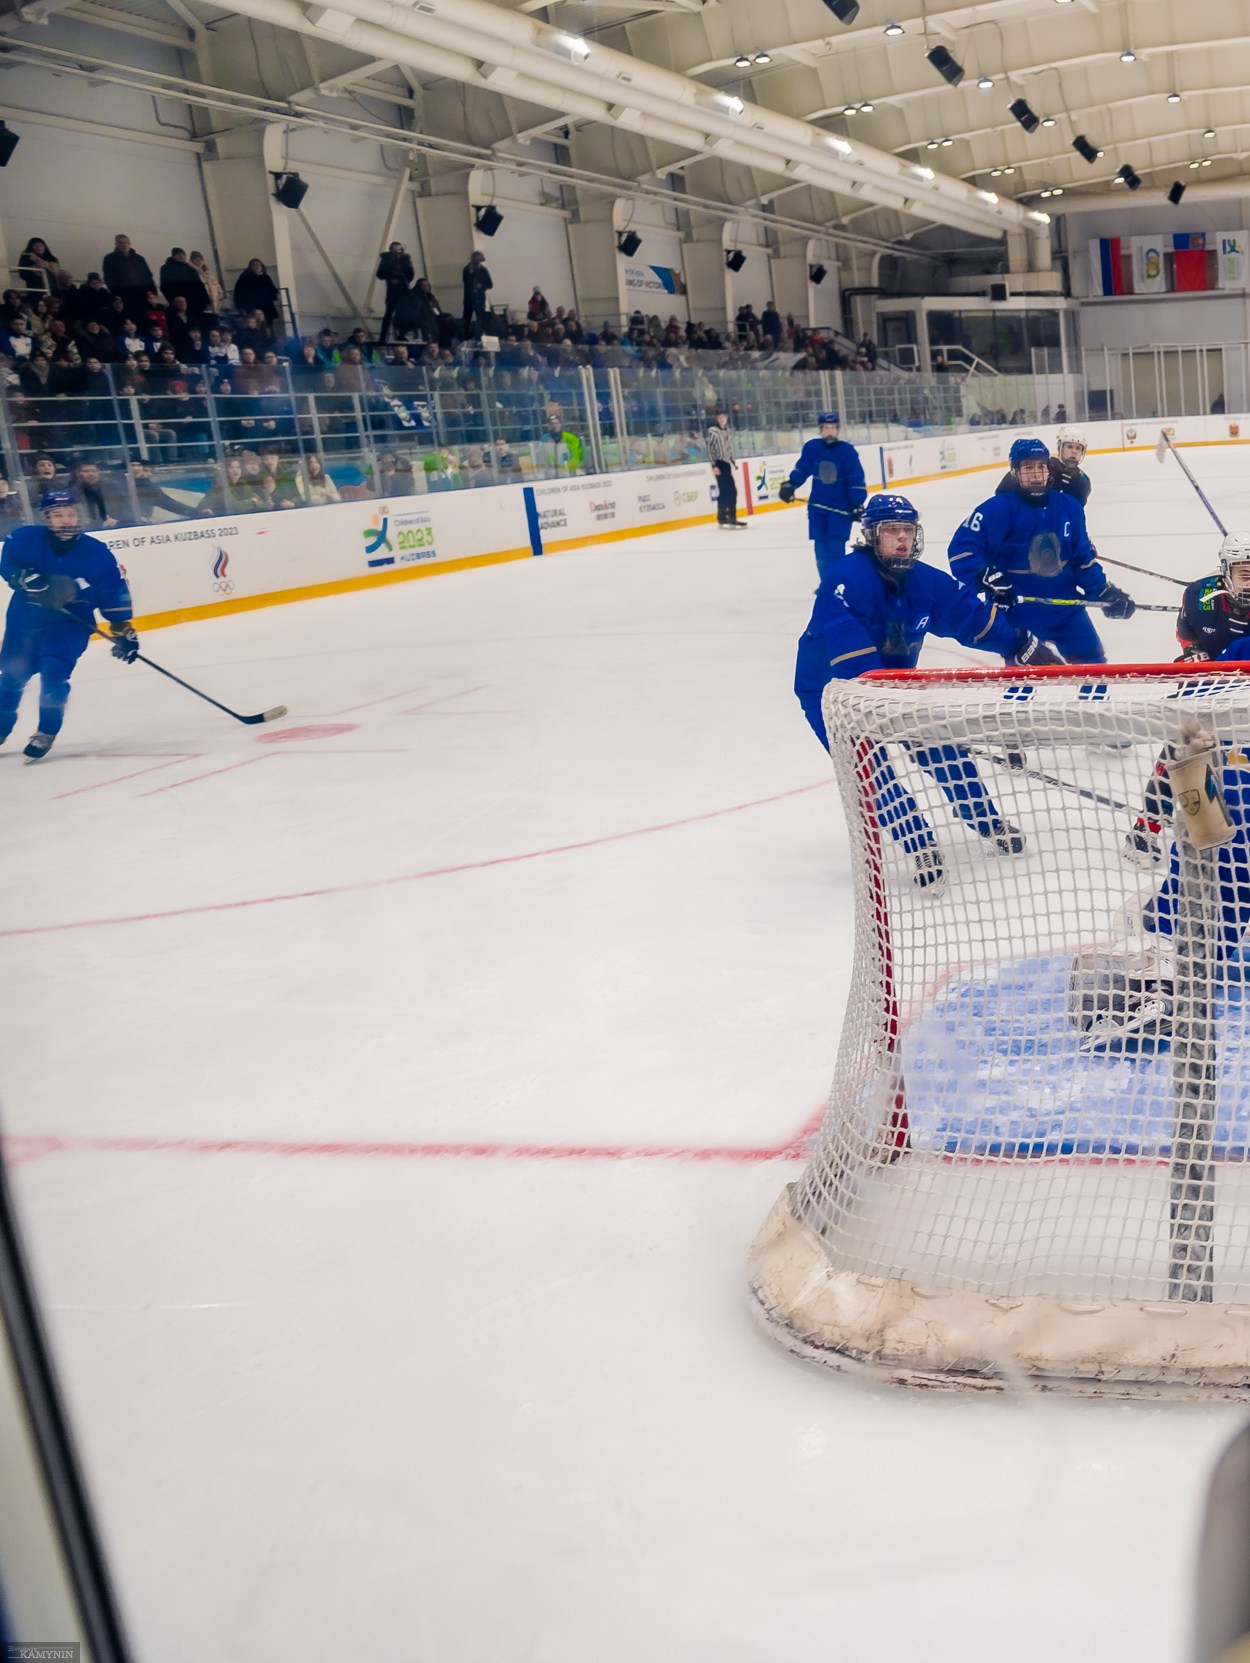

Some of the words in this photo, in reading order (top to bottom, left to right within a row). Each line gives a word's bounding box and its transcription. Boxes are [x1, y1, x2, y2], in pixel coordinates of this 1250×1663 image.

[132, 536, 146, 548] OF
[150, 534, 171, 545] ASIA
[174, 529, 216, 542] KUZBASS
[218, 526, 239, 538] 2023
[397, 527, 433, 550] 2023
